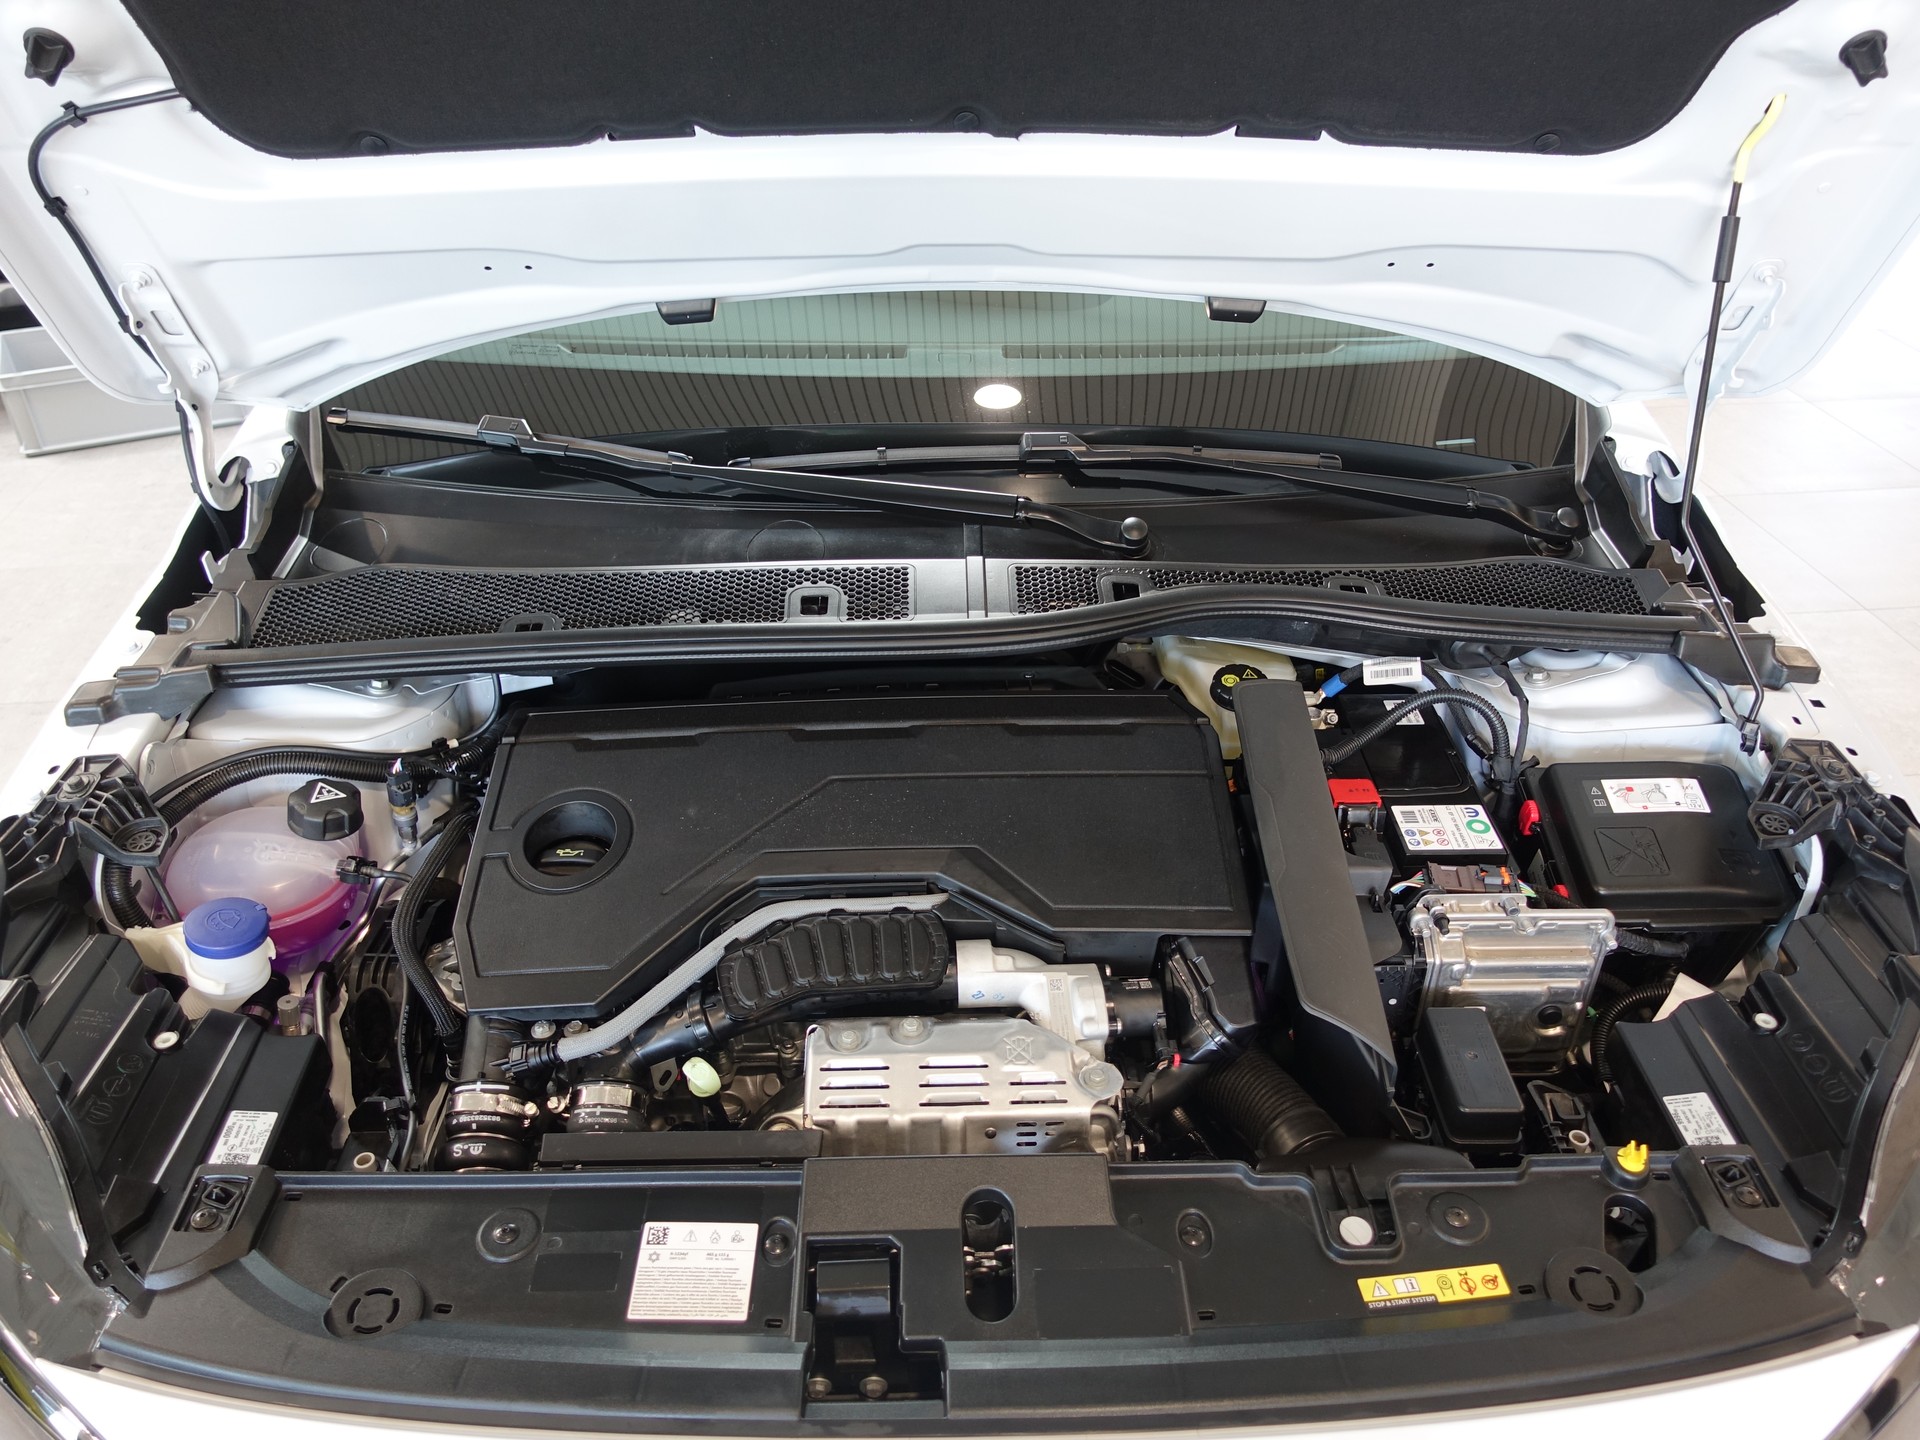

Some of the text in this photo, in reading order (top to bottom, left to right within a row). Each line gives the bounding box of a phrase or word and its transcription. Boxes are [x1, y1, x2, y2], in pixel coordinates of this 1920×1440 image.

[1368, 1300, 1386, 1309] STOP
[1391, 1298, 1411, 1306] START
[1411, 1296, 1436, 1304] SYSTEM
